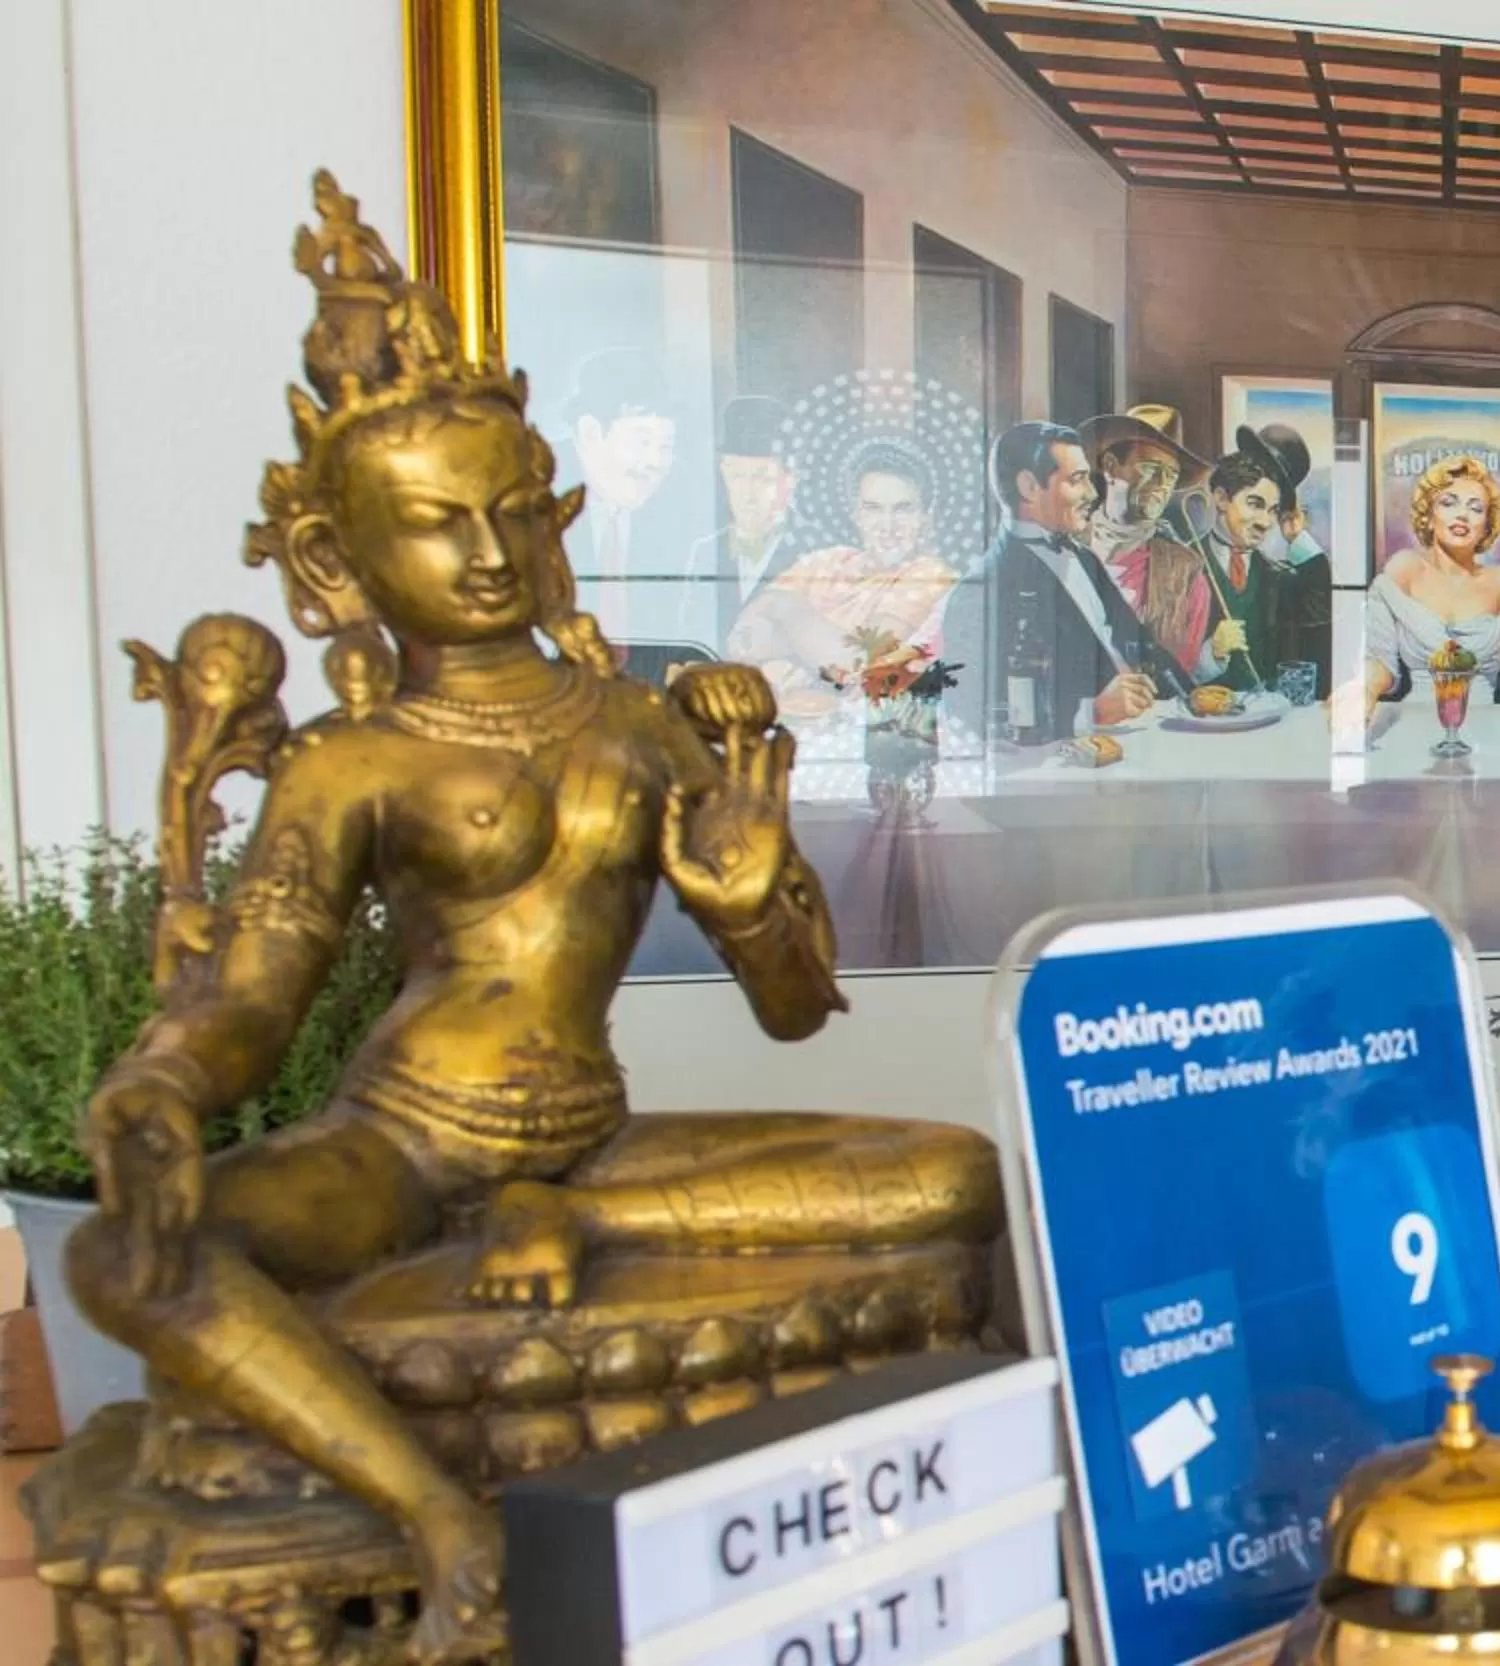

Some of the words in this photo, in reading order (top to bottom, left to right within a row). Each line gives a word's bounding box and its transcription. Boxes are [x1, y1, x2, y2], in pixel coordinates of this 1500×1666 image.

[1054, 998, 1264, 1057] Booking.com
[1065, 1068, 1180, 1114] Traveller
[1183, 1056, 1272, 1095] Review
[1275, 1037, 1362, 1080] Awards
[1363, 1028, 1419, 1066] 2021
[1391, 1211, 1440, 1306] 9
[1141, 1298, 1204, 1338] VIDEO
[717, 1438, 950, 1579] CHECK
[1142, 1540, 1224, 1605] Hotel
